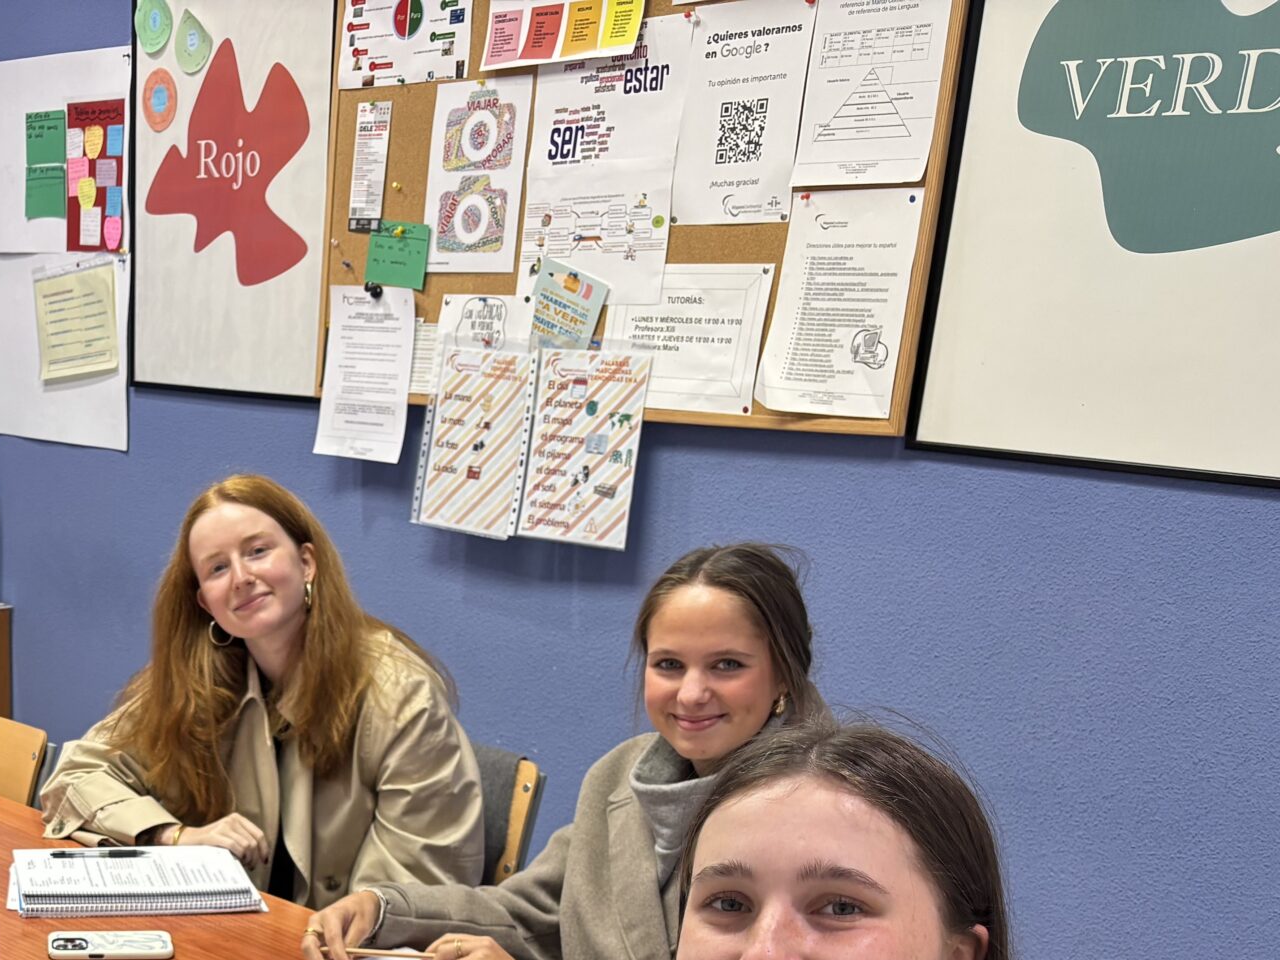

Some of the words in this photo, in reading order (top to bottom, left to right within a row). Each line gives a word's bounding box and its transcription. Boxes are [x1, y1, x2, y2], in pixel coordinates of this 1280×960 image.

[898, 3, 919, 11] Lenguas
[706, 30, 748, 45] ¿Quieres
[750, 24, 803, 38] valorarnos
[704, 50, 717, 59] en
[720, 40, 762, 59] Google
[623, 58, 670, 95] estar
[717, 78, 741, 88] opinión
[750, 72, 787, 83] importante
[1060, 47, 1280, 120] VERD
[466, 98, 500, 112] VIAJAR
[548, 124, 586, 160] ser
[481, 132, 514, 168] PROBAR
[196, 138, 261, 190] Rojo
[438, 194, 460, 236] viajar
[667, 295, 705, 305] TUTORÍAS:
[660, 316, 693, 324] MIÉRCOLES
[661, 335, 684, 343] JUEVES
[547, 380, 555, 390] El
[455, 394, 472, 402] mano
[545, 400, 554, 408] El
[554, 400, 583, 411] planeta
[543, 416, 552, 424] El
[552, 417, 572, 427] mapa
[549, 434, 585, 445] programa
[546, 450, 572, 461] pijama
[546, 467, 567, 477] drama
[538, 500, 566, 511] sistema
[527, 514, 536, 524] El
[536, 516, 570, 529] problema
